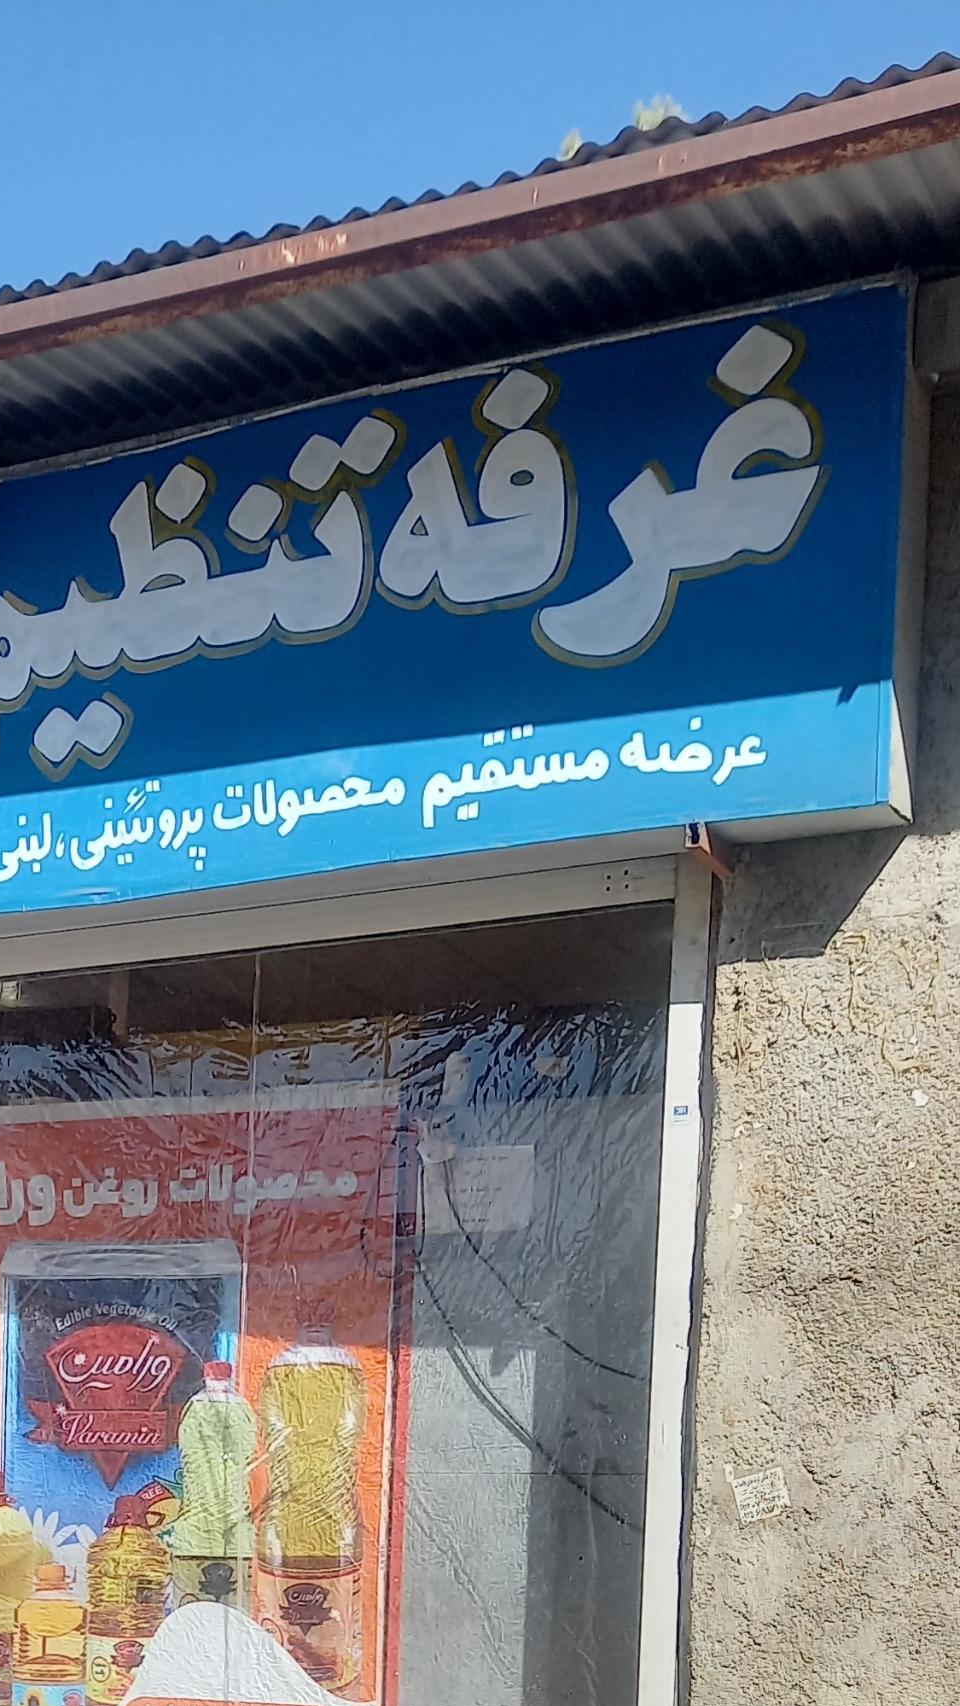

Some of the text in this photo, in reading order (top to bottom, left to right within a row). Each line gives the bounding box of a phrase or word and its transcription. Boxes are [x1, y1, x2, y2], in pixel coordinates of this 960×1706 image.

[377, 322, 826, 660] غرفه
[422, 724, 610, 829] مستقیم
[619, 716, 768, 786] عرضه
[213, 774, 407, 837] محصولات
[63, 1166, 159, 1218] روغن
[170, 1163, 358, 1214] محصولات
[55, 1306, 92, 1332] Edible
[94, 1302, 156, 1324] Vegetable
[58, 1337, 171, 1397] ورامین
[62, 1413, 163, 1445] Varamin
[140, 1484, 164, 1501] REE
